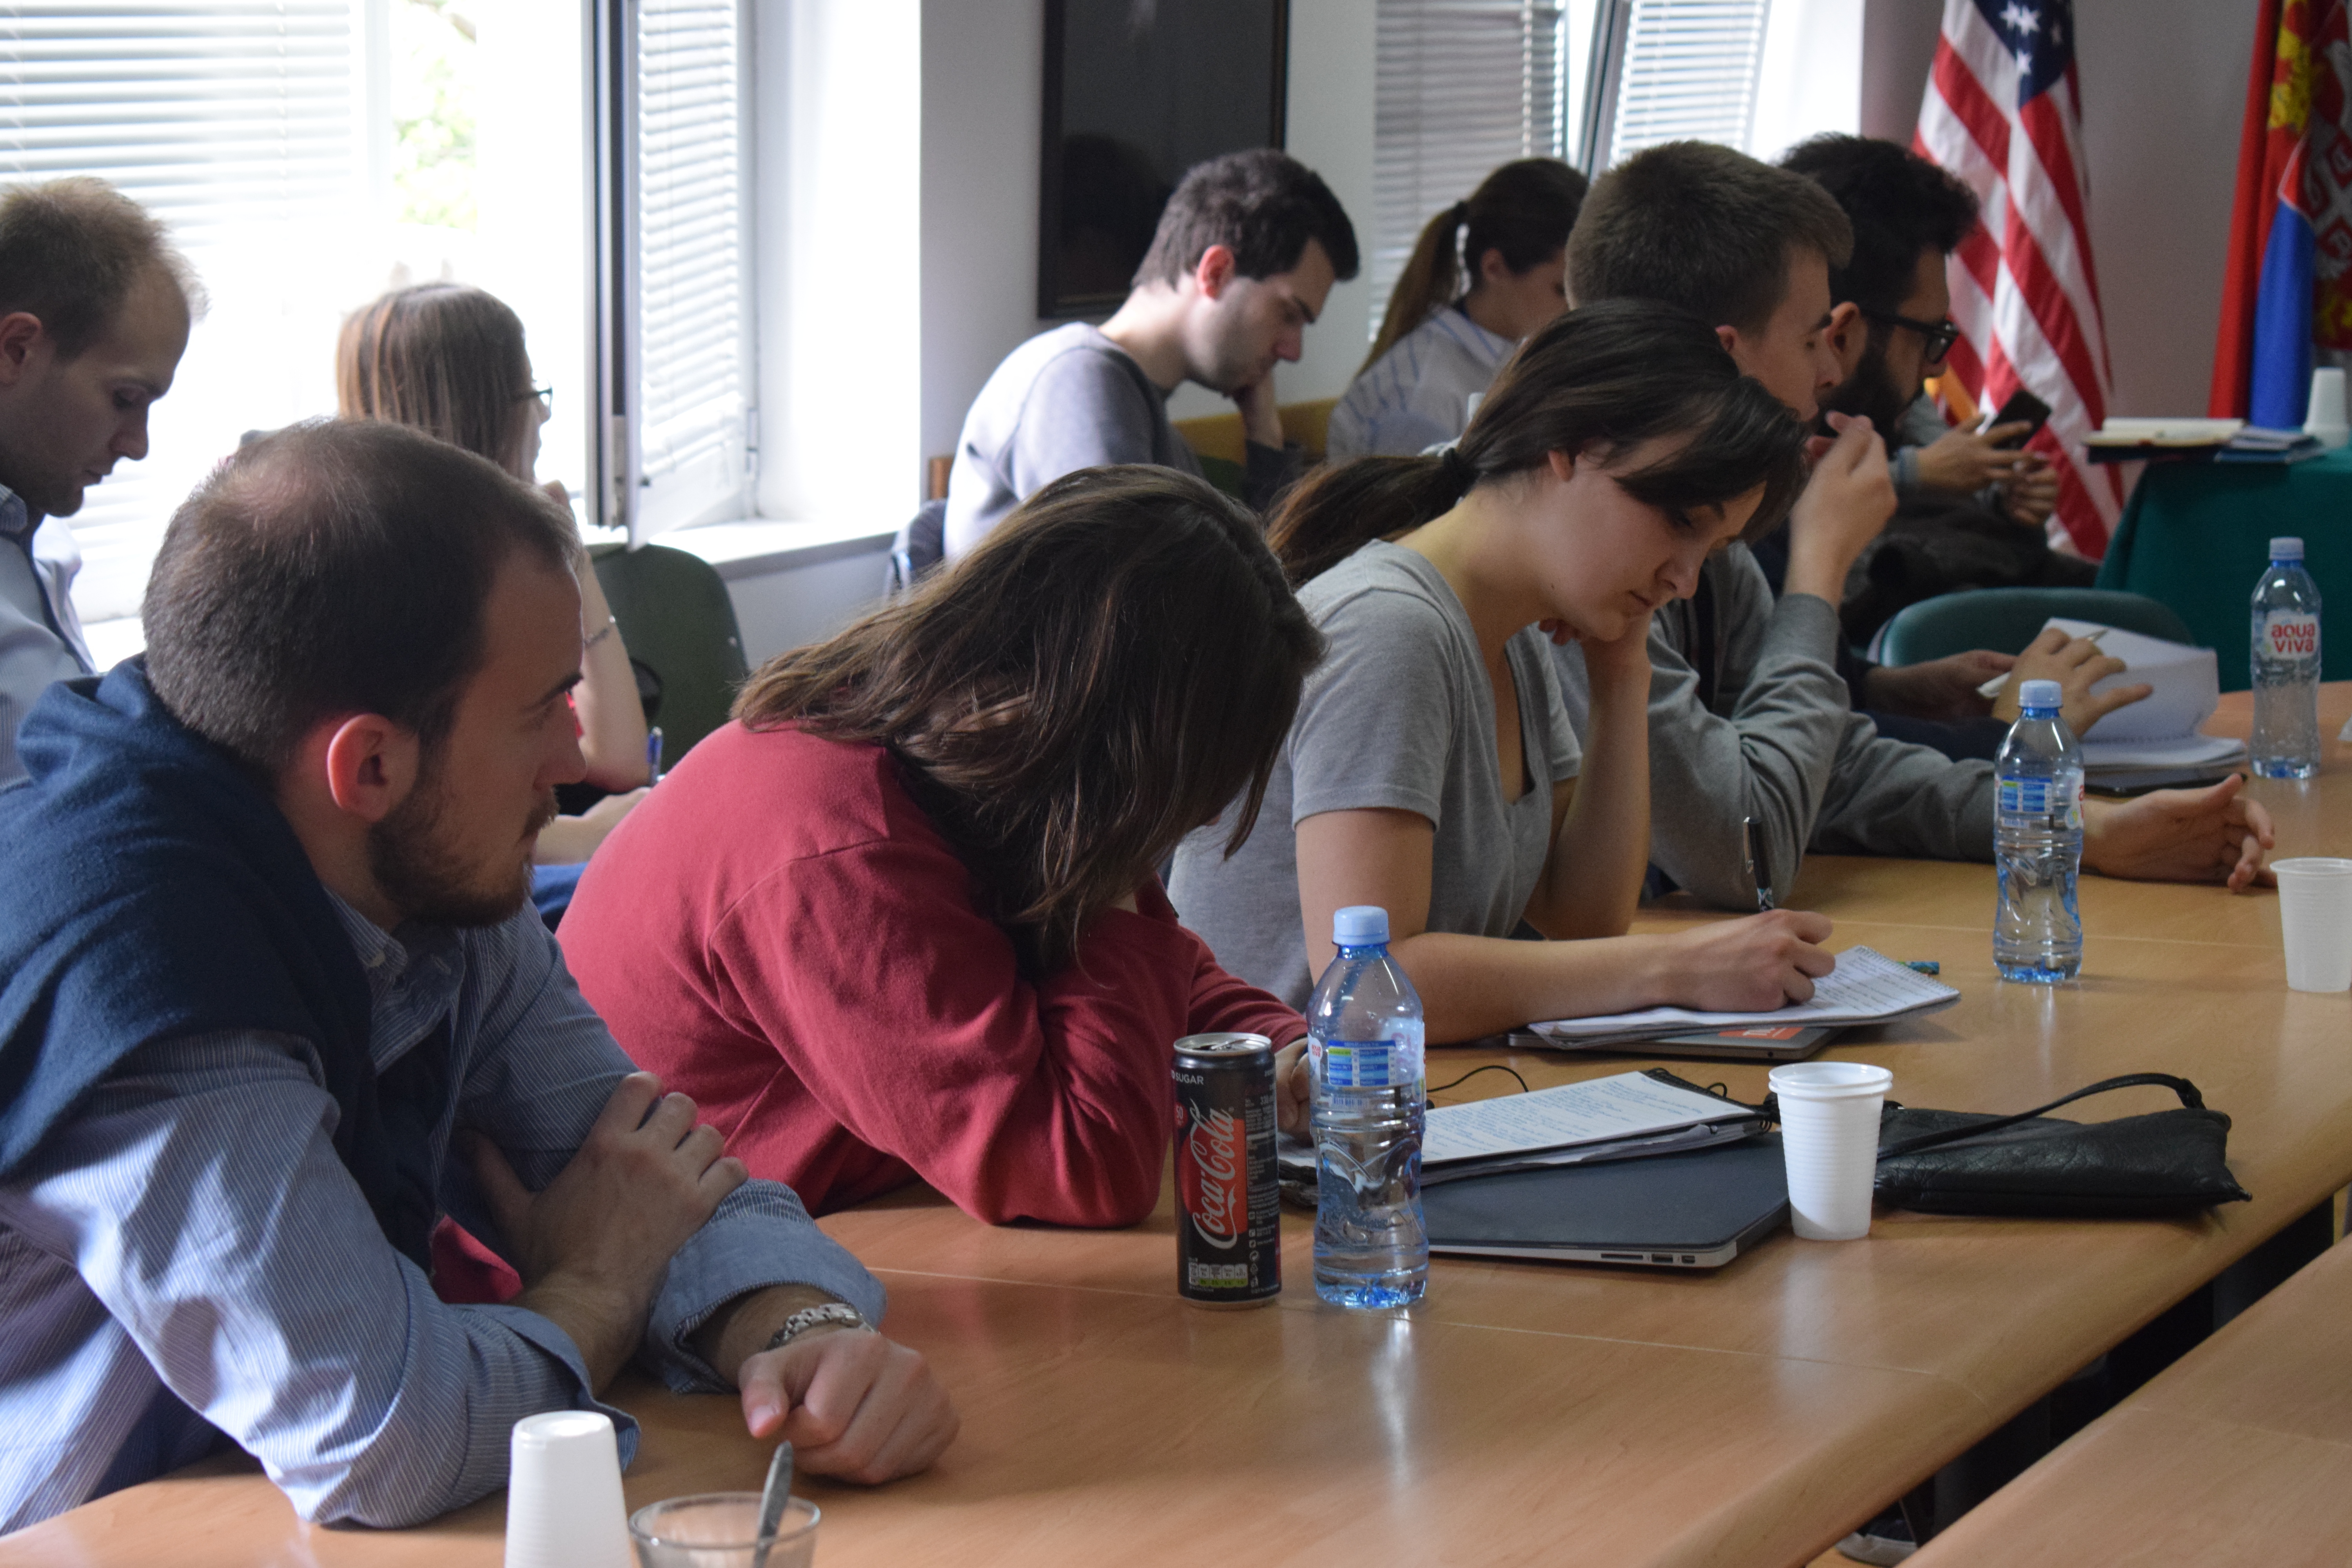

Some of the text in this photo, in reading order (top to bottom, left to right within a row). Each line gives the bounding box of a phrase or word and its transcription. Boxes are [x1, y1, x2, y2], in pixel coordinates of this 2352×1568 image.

[2272, 622, 2315, 639] aqua
[2274, 639, 2314, 653] viva
[1176, 1072, 1204, 1085] SUGAR
